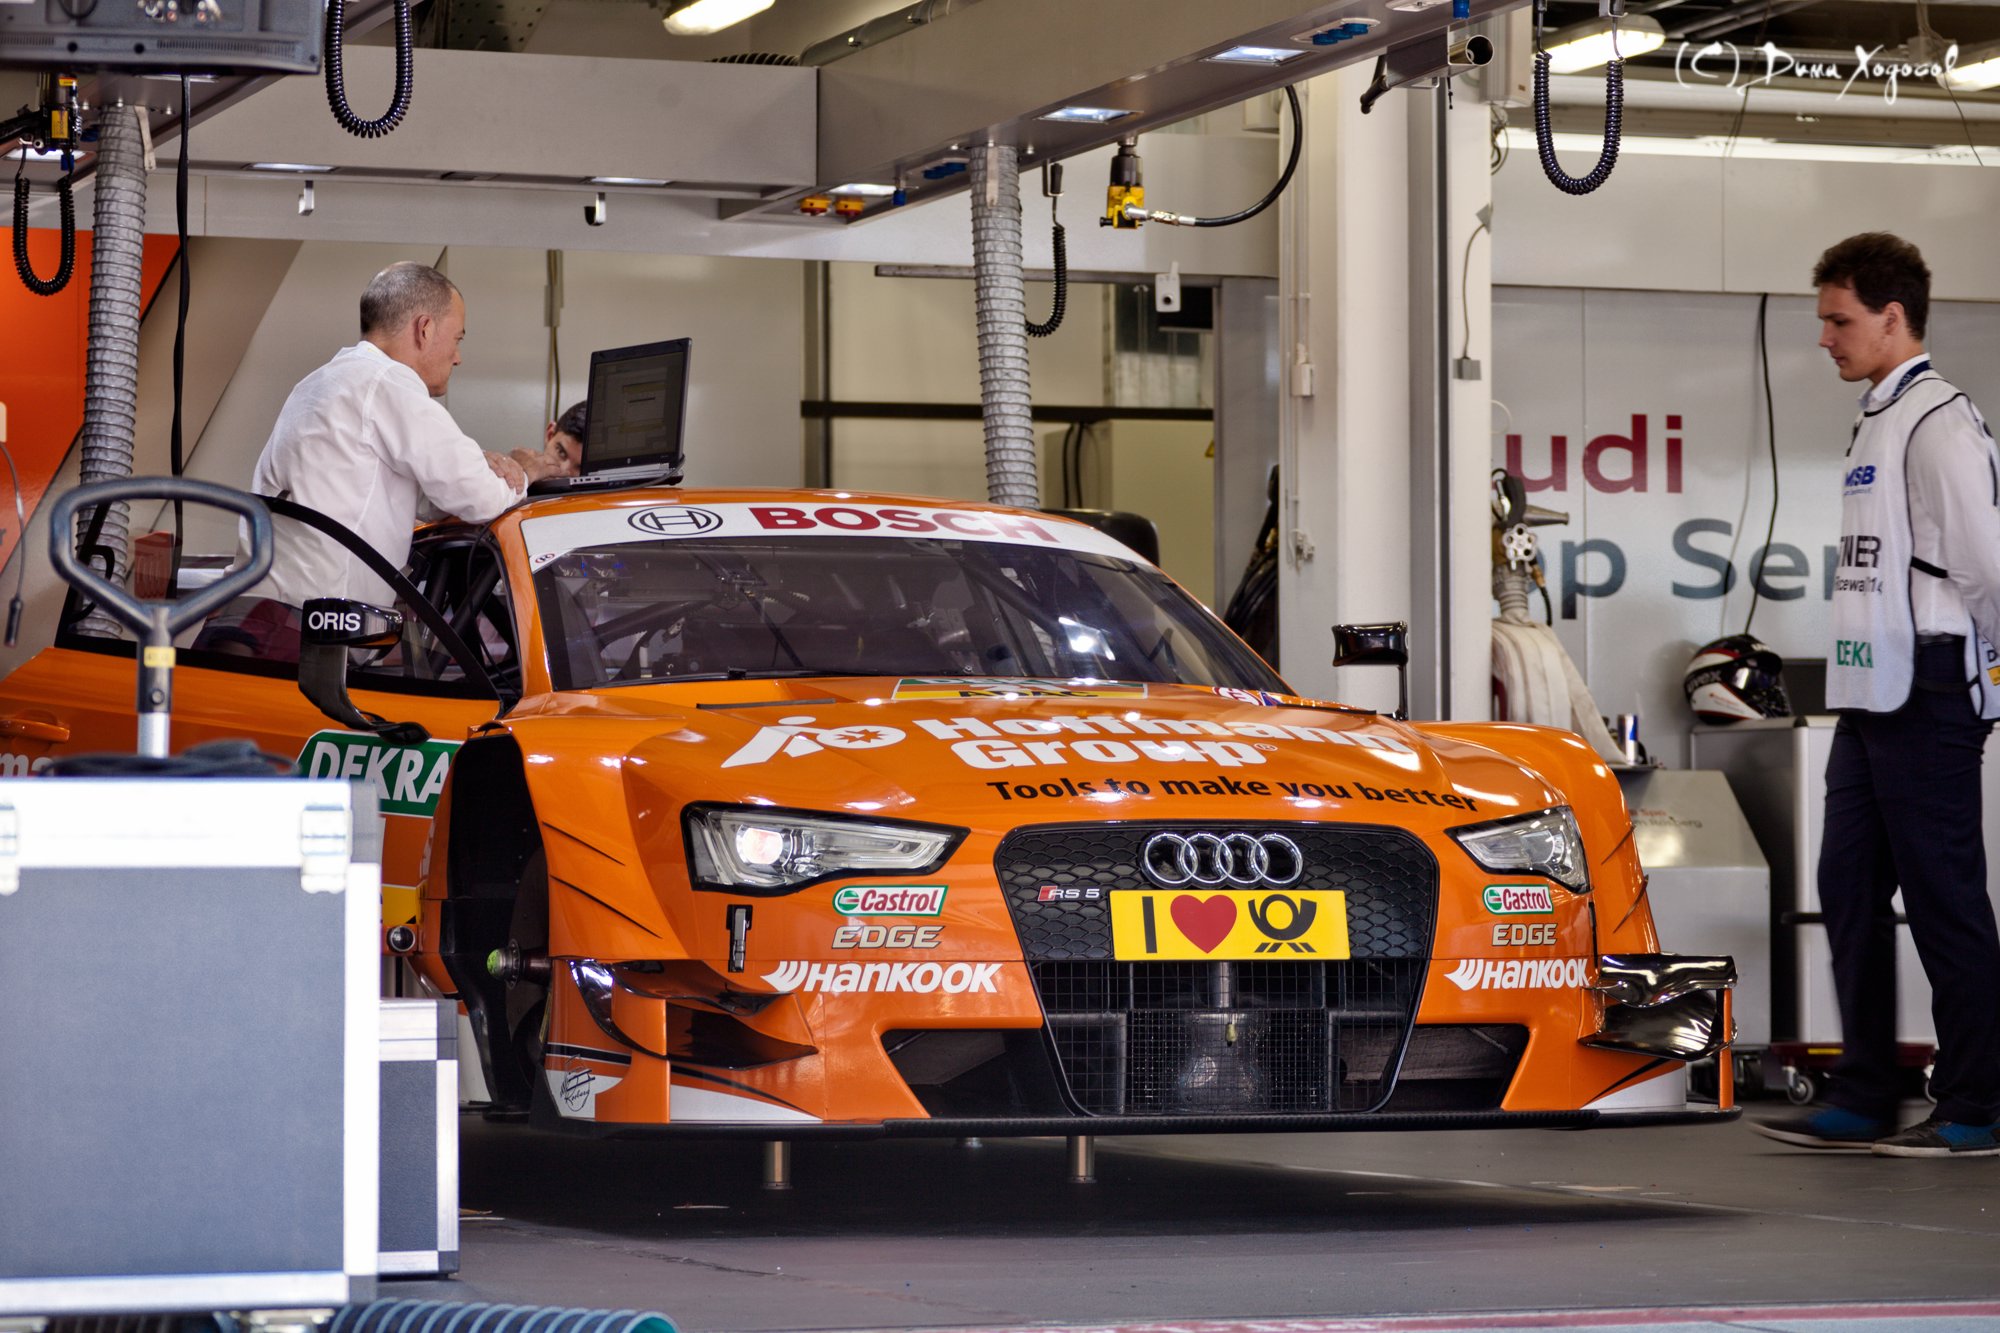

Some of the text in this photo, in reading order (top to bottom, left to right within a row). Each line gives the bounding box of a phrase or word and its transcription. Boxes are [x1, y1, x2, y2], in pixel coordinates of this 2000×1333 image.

[1492, 414, 1682, 494] udi
[747, 507, 1061, 543] BOSCH
[1527, 538, 1627, 620] p
[308, 611, 361, 631] ORIS
[912, 715, 1414, 753] Hoffmann
[308, 741, 450, 804] DEKRA
[987, 776, 1479, 814] Tools to make you better
[860, 888, 938, 912] Castrol
[1048, 888, 1100, 898] RS 5
[1502, 888, 1551, 911] Castrol
[832, 925, 946, 949] EDGE
[1142, 896, 1157, 954] I
[1492, 923, 1557, 946] EDGE
